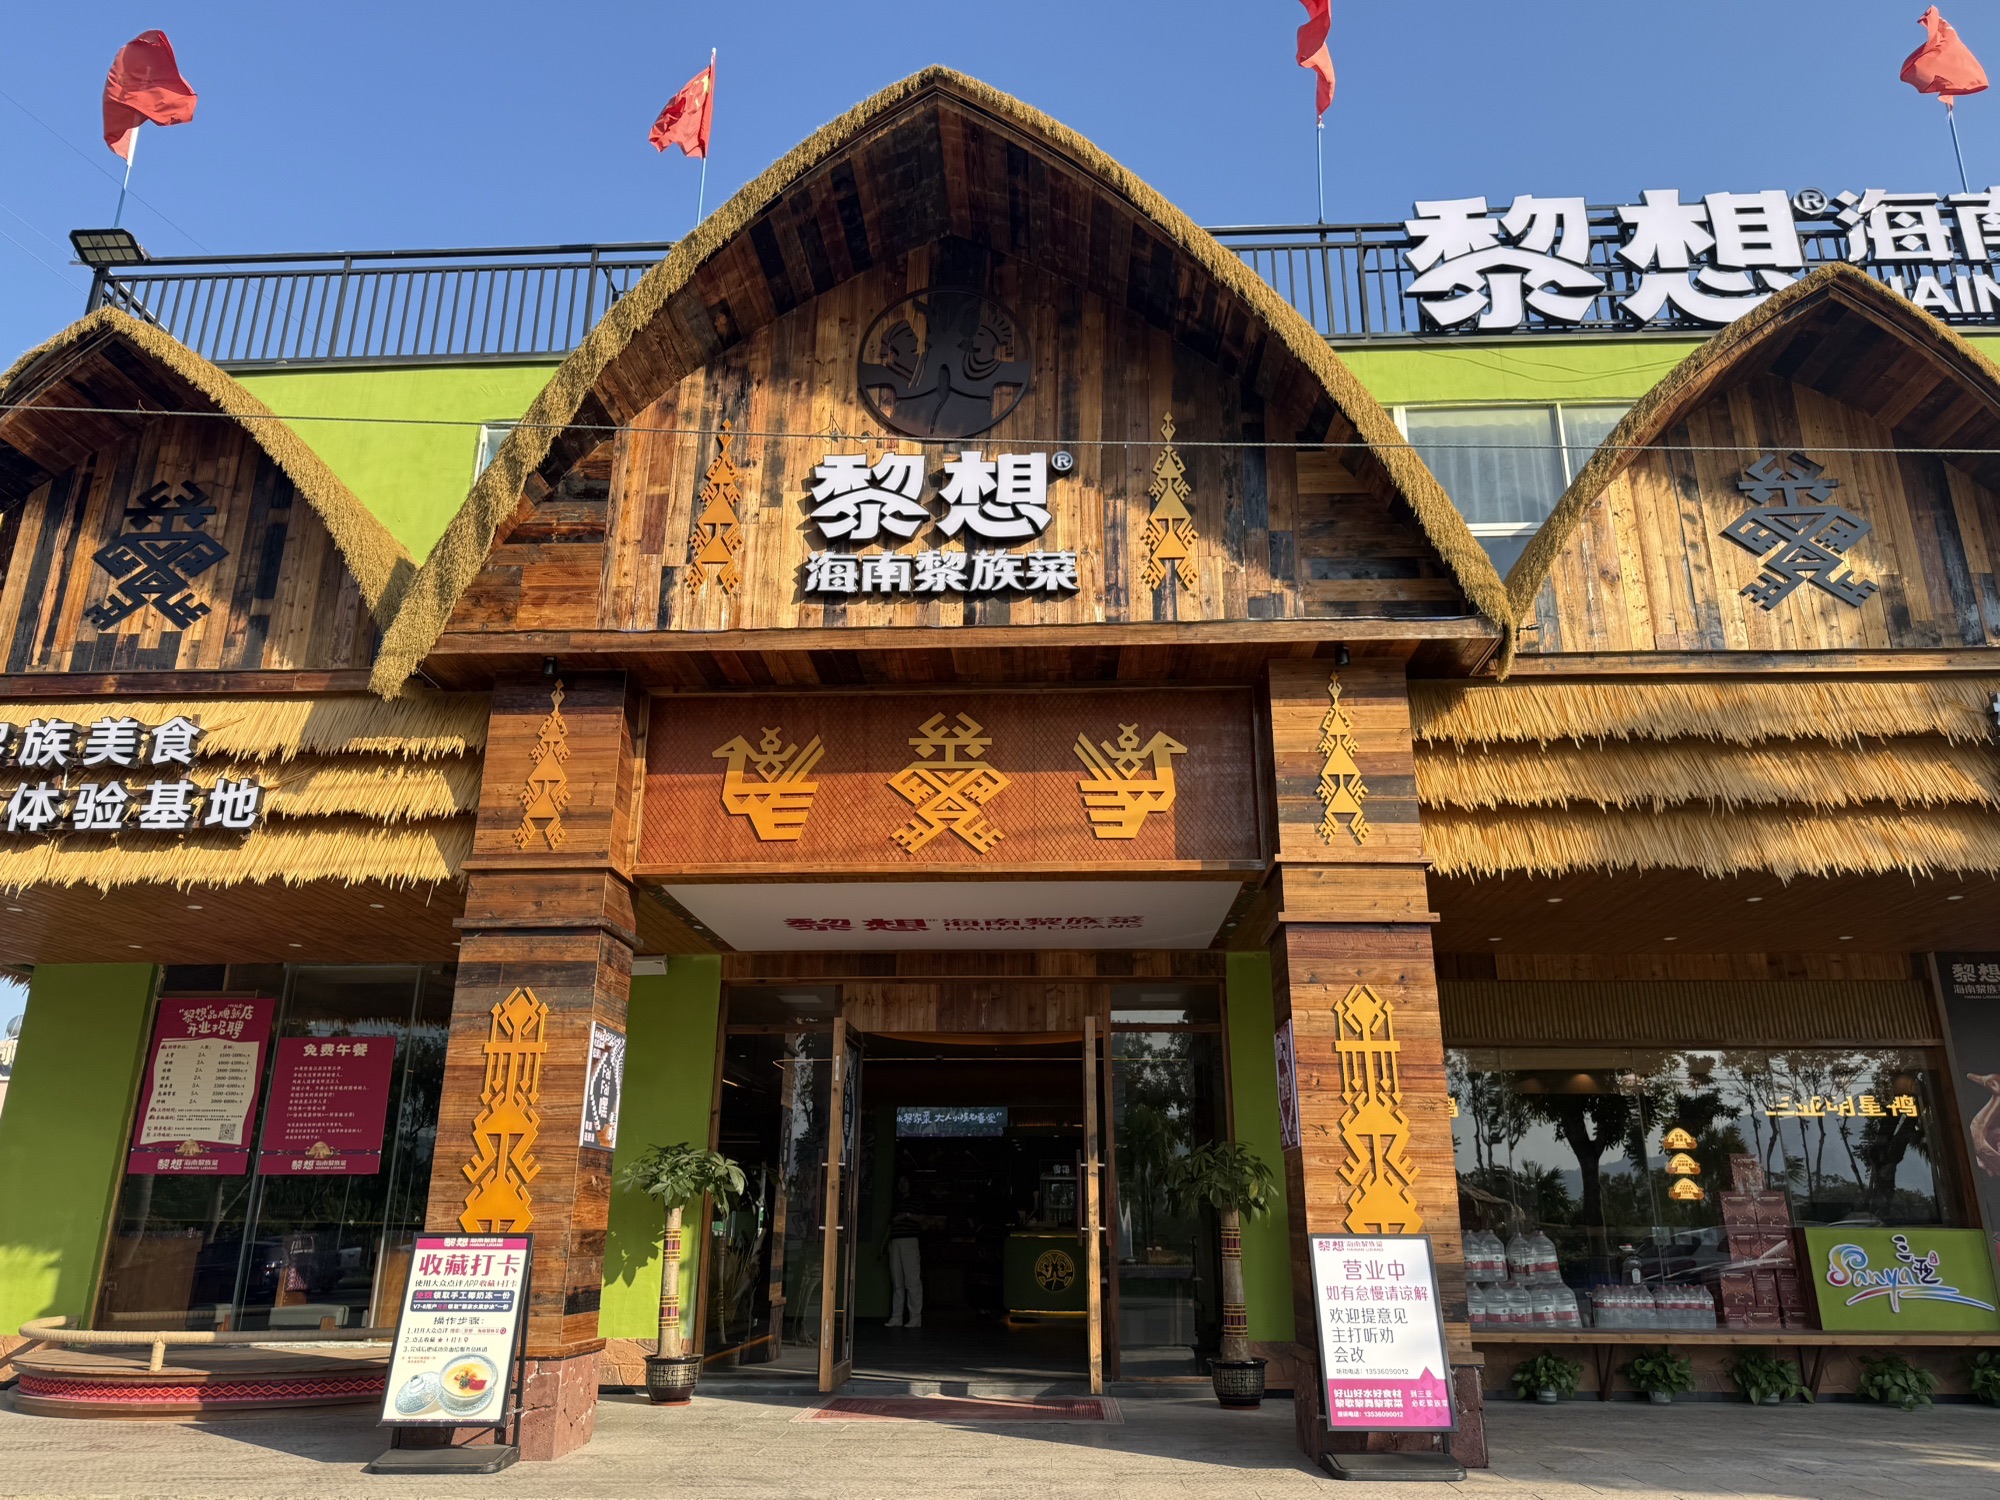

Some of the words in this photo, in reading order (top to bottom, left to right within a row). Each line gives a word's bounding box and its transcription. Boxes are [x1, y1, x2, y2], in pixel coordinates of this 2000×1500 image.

[804, 548, 1081, 592] 海南黎族菜
[0, 717, 201, 766] 族美食
[7, 779, 260, 831] 体验基地
[187, 1020, 244, 1039] 开业招聘
[303, 1043, 368, 1057] 免费午餐
[1318, 1240, 1344, 1251] 黎想
[418, 1254, 520, 1276] 收藏打卡
[1342, 1259, 1405, 1281] 营业中
[1828, 1244, 1917, 1311] Sanya
[1326, 1285, 1429, 1302] 如有怠慢请谅解
[1329, 1307, 1408, 1324] 欢迎提意见
[1331, 1327, 1394, 1343] 主打听劝
[1334, 1346, 1366, 1363] 会改
[1333, 1389, 1402, 1398] 好山好水好食材
[1410, 1389, 1433, 1398] 到三亚
